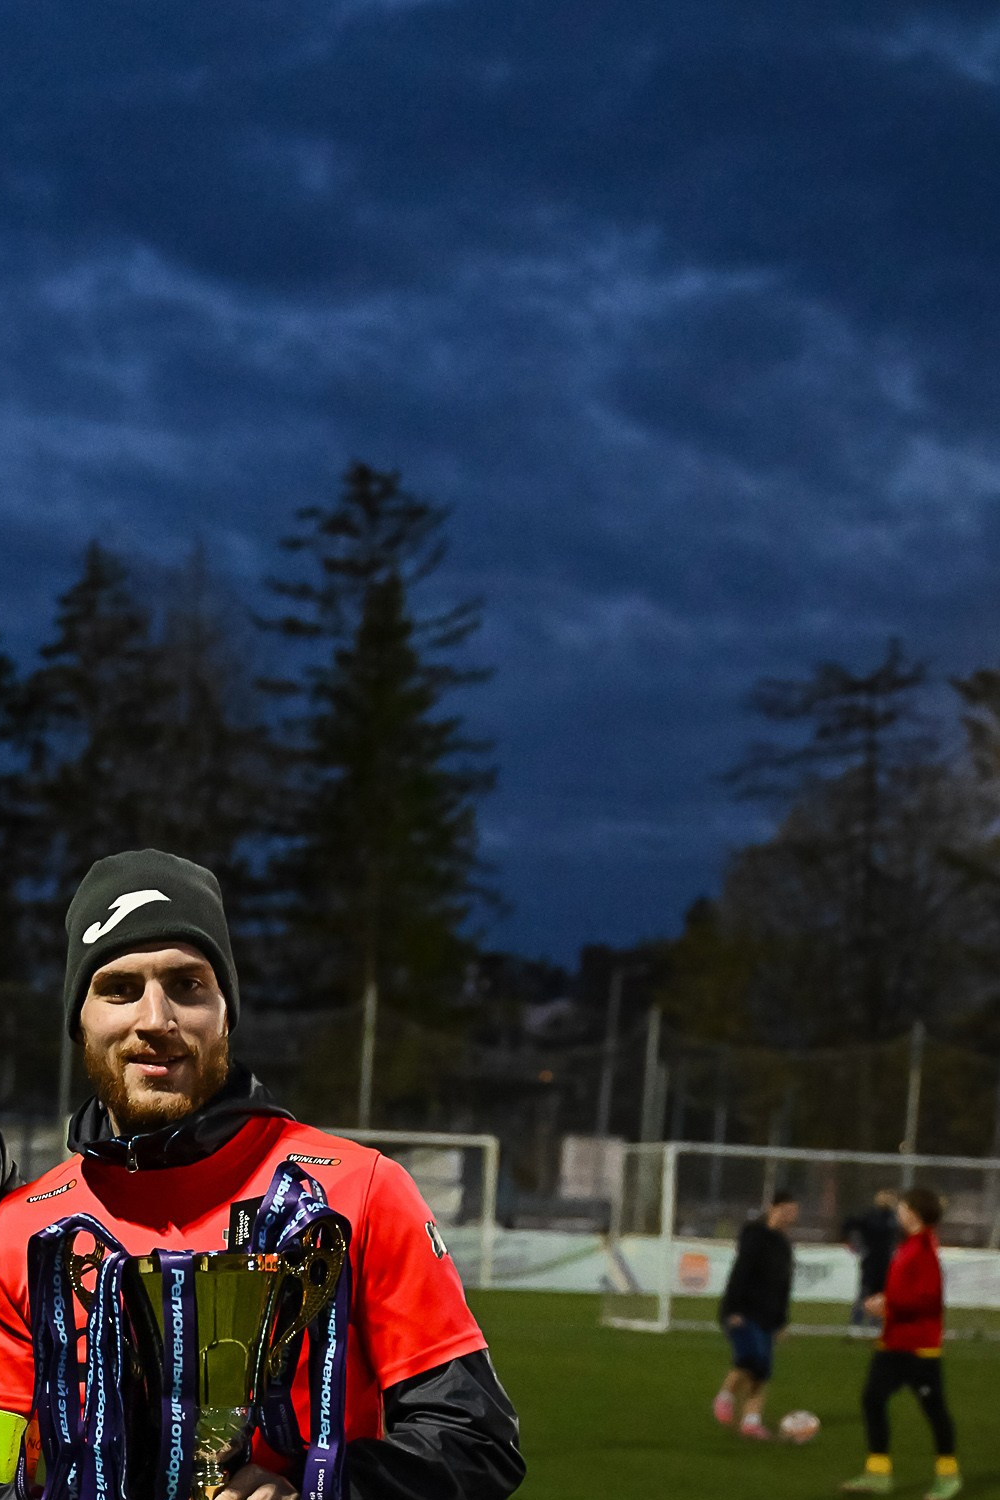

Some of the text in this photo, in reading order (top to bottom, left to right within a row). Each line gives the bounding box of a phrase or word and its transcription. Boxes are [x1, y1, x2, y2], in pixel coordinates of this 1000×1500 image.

[289, 1154, 331, 1165] WINLINE
[29, 1184, 68, 1203] WINLINE
[53, 1273, 70, 1398] отборочный
[170, 1267, 186, 1421] Региональный
[57, 1398, 72, 1444] этап
[94, 1366, 108, 1489] отборочный
[317, 1468, 325, 1491] СОЮЗ
